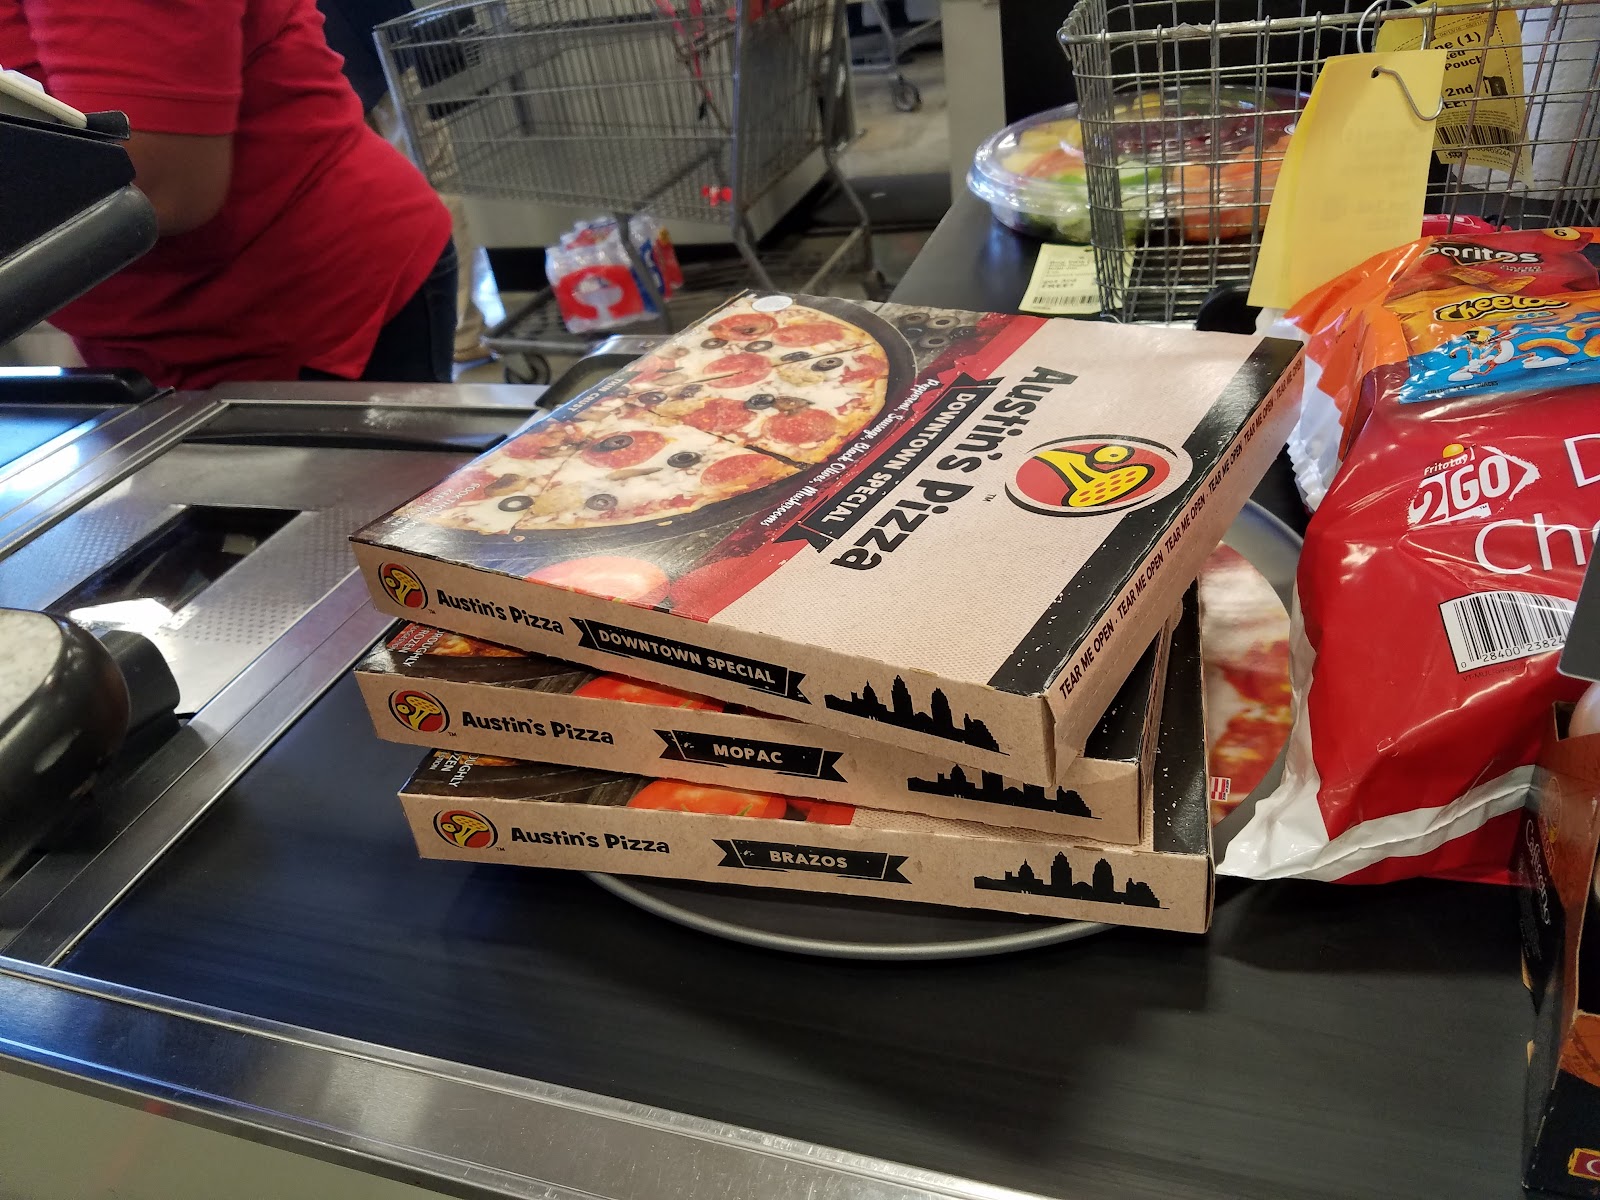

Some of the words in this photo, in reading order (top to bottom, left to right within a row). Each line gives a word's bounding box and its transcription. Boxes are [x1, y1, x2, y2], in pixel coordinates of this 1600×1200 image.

[1457, 32, 1481, 46] (1)
[1445, 84, 1474, 97] 2nd
[1554, 228, 1567, 236] 6
[598, 378, 625, 392] THIN
[894, 378, 940, 411] Pepperoni,
[568, 392, 600, 412] CRUST
[860, 412, 903, 440] Sausage,
[883, 392, 977, 470] DOWNTOWN
[936, 366, 1079, 473] Austin's
[837, 442, 871, 462] Black
[809, 463, 846, 483] Olives,
[431, 488, 454, 503] KEEP
[454, 483, 480, 499] COOK
[821, 471, 892, 523] SPECIAL
[1412, 455, 1511, 525] 2GO
[760, 485, 818, 527] Mushrooms
[829, 478, 975, 570] Pizza
[1059, 664, 1083, 700] TEAR
[1080, 647, 1094, 672] ME
[1093, 619, 1114, 652] OPEN
[1116, 589, 1137, 620] TEAR
[1135, 574, 1147, 596] ME
[1146, 550, 1164, 580] OPEN
[1165, 527, 1182, 553] TEAR
[1181, 514, 1191, 533] ME
[1190, 494, 1206, 519] OPEN
[1208, 471, 1223, 494] TEAR
[1221, 459, 1230, 477] ME
[1230, 441, 1243, 464] OPEN
[1243, 423, 1256, 445] TEAR
[1255, 413, 1262, 428] ME
[1262, 397, 1274, 419] OPEN
[1475, 513, 1600, 575] Ch
[436, 589, 507, 621] Austin's
[508, 605, 564, 635] Pizza
[402, 629, 445, 667] ROUGHLY
[599, 629, 702, 665] DOWNTOWN
[706, 656, 775, 684] SPECIAL
[1482, 646, 1521, 663] 28400
[1526, 637, 1566, 652] 23824
[462, 711, 547, 737] Austin's
[550, 721, 614, 745] Pizza
[713, 743, 783, 764] MOPAC
[511, 827, 600, 848] Austin's
[604, 833, 670, 854] Pizza
[769, 851, 848, 869] BRAZOS
